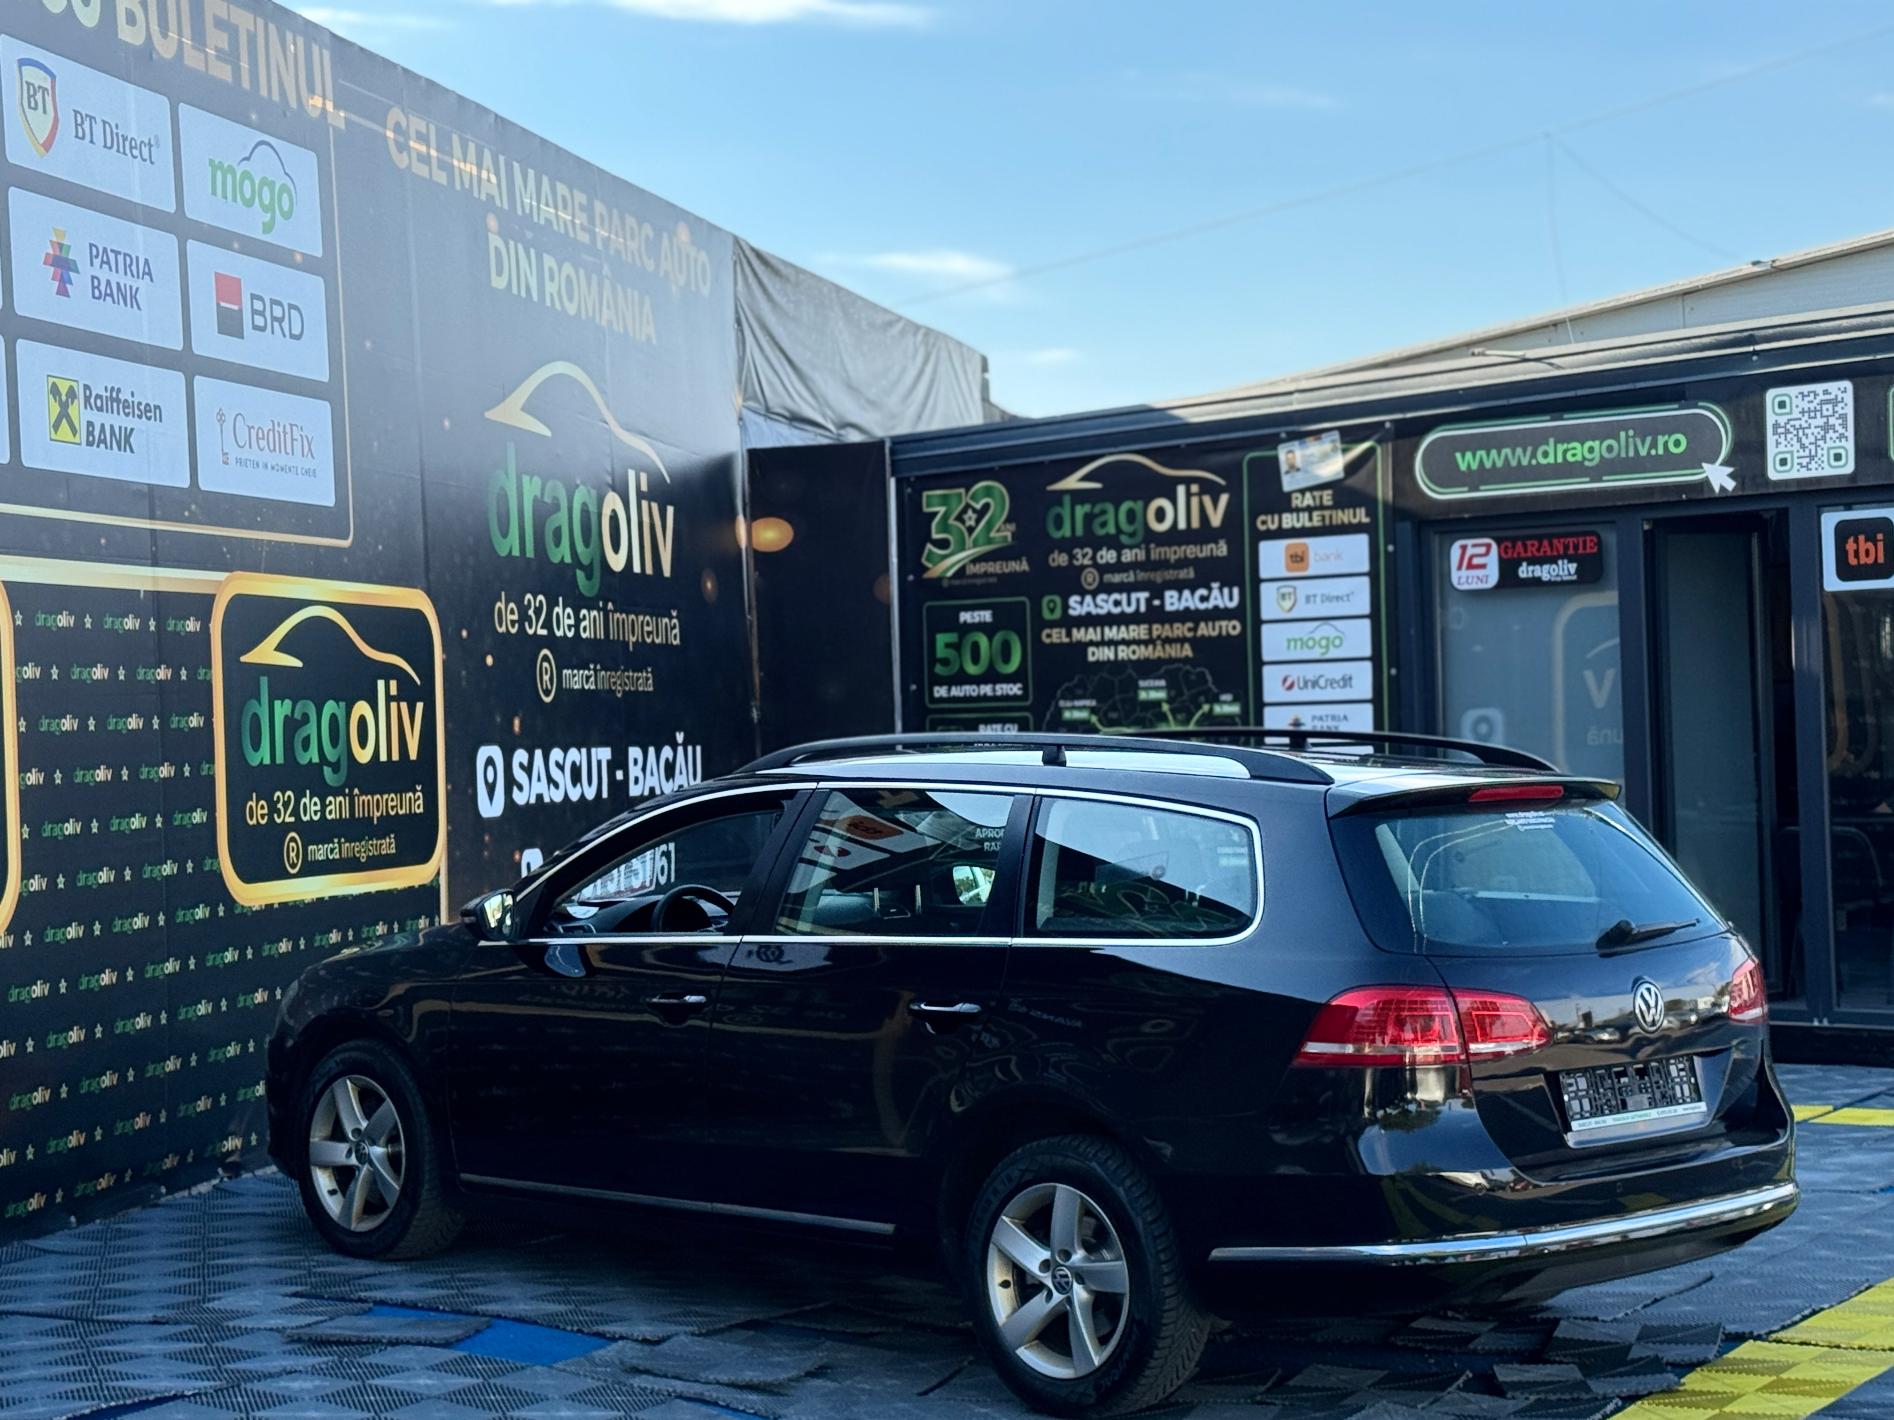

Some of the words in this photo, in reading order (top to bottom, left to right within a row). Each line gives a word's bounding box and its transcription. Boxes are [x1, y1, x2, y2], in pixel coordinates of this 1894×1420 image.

[25, 80, 49, 114] BT
[72, 108, 97, 145] BT
[208, 157, 295, 234] mogo
[386, 106, 447, 186] CEL
[452, 134, 509, 210] MAI
[513, 161, 590, 243] MARE
[594, 199, 654, 272] PARC
[660, 230, 711, 297] AUTO
[88, 242, 154, 283] PATRIA
[91, 275, 142, 311] BANK
[488, 231, 538, 302] DIN
[543, 253, 657, 345] ROMÂNIA
[250, 292, 305, 341] BRD
[83, 383, 163, 423] Raiffeisen
[85, 420, 135, 454] BANK
[233, 411, 316, 460] CreditFix
[1454, 429, 1687, 472] www.dragoliv.ro
[1291, 490, 1333, 508] RATE
[487, 441, 675, 597] dragoliv
[1046, 484, 1230, 546] dragoliv
[1256, 514, 1279, 530] CU
[1281, 507, 1370, 529] BULETINUL
[1048, 551, 1068, 566] de
[1072, 548, 1092, 566] 32
[1097, 546, 1118, 564] de
[1121, 545, 1146, 562] ani
[1149, 539, 1228, 563] împreună
[1456, 542, 1492, 571] 12
[1500, 536, 1598, 559] GARANTIE
[1846, 533, 1884, 566] tbi
[1457, 575, 1489, 586] LUNI
[1518, 559, 1577, 581] dragoliv
[1068, 592, 1149, 616] SASCUT
[1164, 582, 1239, 611] BACĂU
[1305, 593, 1317, 604] BT
[35, 610, 75, 631] dragoliv
[103, 614, 141, 633] dragoliv
[166, 616, 201, 635] dragoliv
[494, 591, 518, 634] de
[524, 593, 548, 636] 32
[552, 596, 575, 638] de
[580, 601, 604, 640] ani
[608, 602, 681, 652] împreună
[959, 610, 993, 624] PESTE
[1041, 628, 1070, 644] CEL
[1072, 626, 1101, 642] MAI
[1103, 625, 1149, 641] MARE
[1152, 623, 1194, 639] PARC
[1196, 620, 1241, 637] AUTO
[933, 630, 1022, 676] 500
[1087, 647, 1115, 662] DIN
[1117, 641, 1193, 661] ROMÂNIA
[1286, 634, 1344, 656] mogo
[70, 663, 109, 683] dragoliv
[136, 664, 172, 684] dragoliv
[562, 663, 596, 691] marcă
[596, 664, 654, 698] înregistrată
[1297, 673, 1353, 690] UniCredit
[933, 685, 948, 698] DE
[949, 684, 978, 698] AUTO
[980, 683, 994, 697] PE
[995, 682, 1023, 696] STOC
[39, 714, 79, 735] dragoliv
[107, 713, 144, 734] dragoliv
[170, 712, 205, 732] dragoliv
[1311, 714, 1348, 723] PATRIA
[241, 676, 424, 786] dragoliv
[73, 765, 112, 786] dragoliv
[139, 762, 175, 783] dragoliv
[512, 747, 612, 805] SASCUT
[628, 731, 702, 797] BACĂU
[246, 793, 268, 825] de
[273, 790, 295, 824] 32
[300, 789, 321, 822] de
[326, 788, 349, 820] ani
[354, 785, 423, 825] împreună
[41, 818, 82, 840] dragoliv
[109, 813, 147, 834] dragoliv
[172, 808, 208, 828] dragoliv
[308, 838, 339, 861] marcă
[340, 834, 396, 862] înregistrată
[76, 867, 115, 889] dragoliv
[142, 860, 178, 880] dragoliv
[112, 912, 149, 934] dragoliv
[175, 903, 210, 925] dragoliv
[44, 922, 84, 944] dragoliv
[206, 947, 239, 968] dragoliv
[262, 938, 293, 958] dragoliv
[78, 968, 117, 991] dragoliv
[145, 957, 181, 979] dragoliv
[8, 980, 50, 1004] dragoliv
[178, 1000, 213, 1021] dragoliv
[114, 1012, 152, 1035] dragoliv
[46, 1025, 86, 1049] dragoliv
[79, 1070, 119, 1094] dragoliv
[9, 1086, 51, 1111] dragoliv
